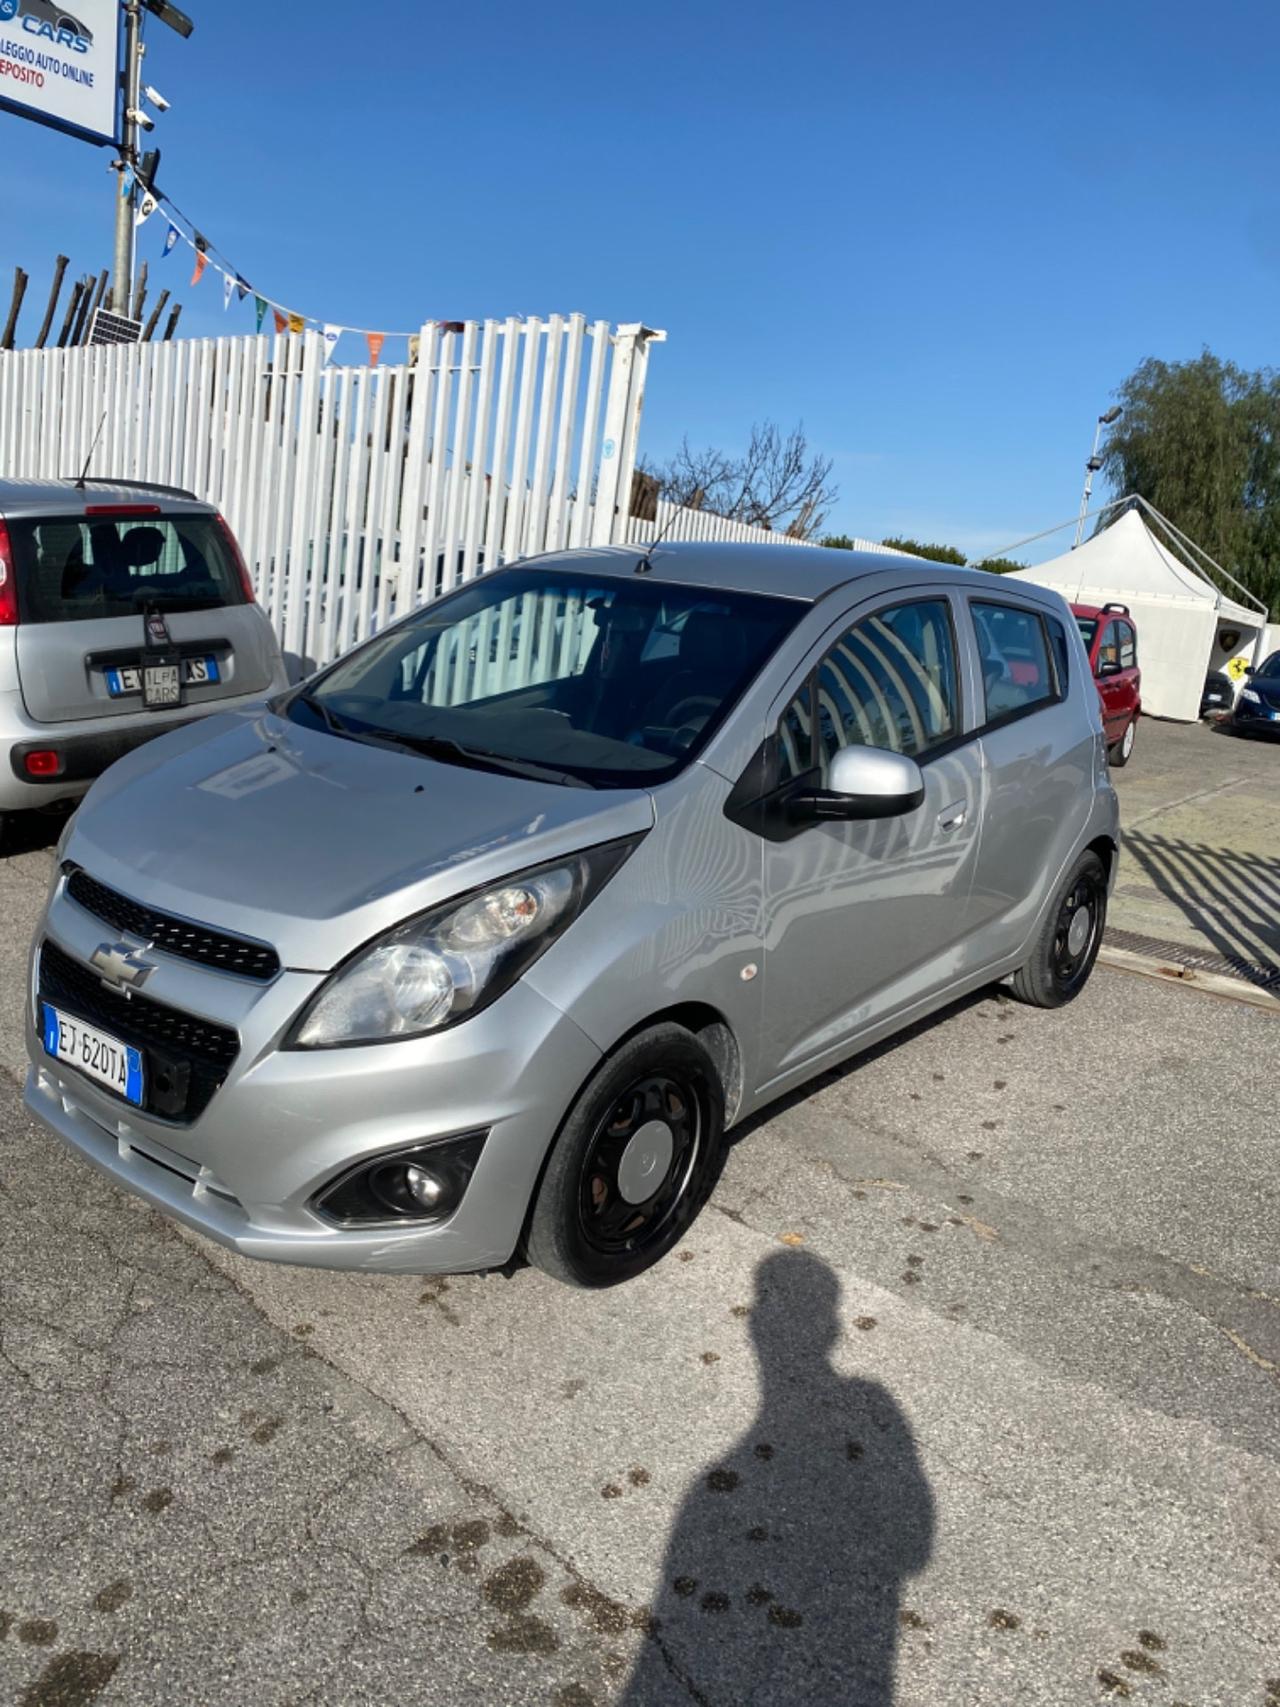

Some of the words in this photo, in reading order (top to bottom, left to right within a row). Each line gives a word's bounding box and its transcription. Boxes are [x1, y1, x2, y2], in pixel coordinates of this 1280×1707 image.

[22, 15, 88, 53] CARS
[0, 38, 35, 64] LEGGIO
[35, 51, 60, 75] AUTO
[62, 61, 94, 88] ONLINE
[0, 59, 45, 88] EPOSITO
